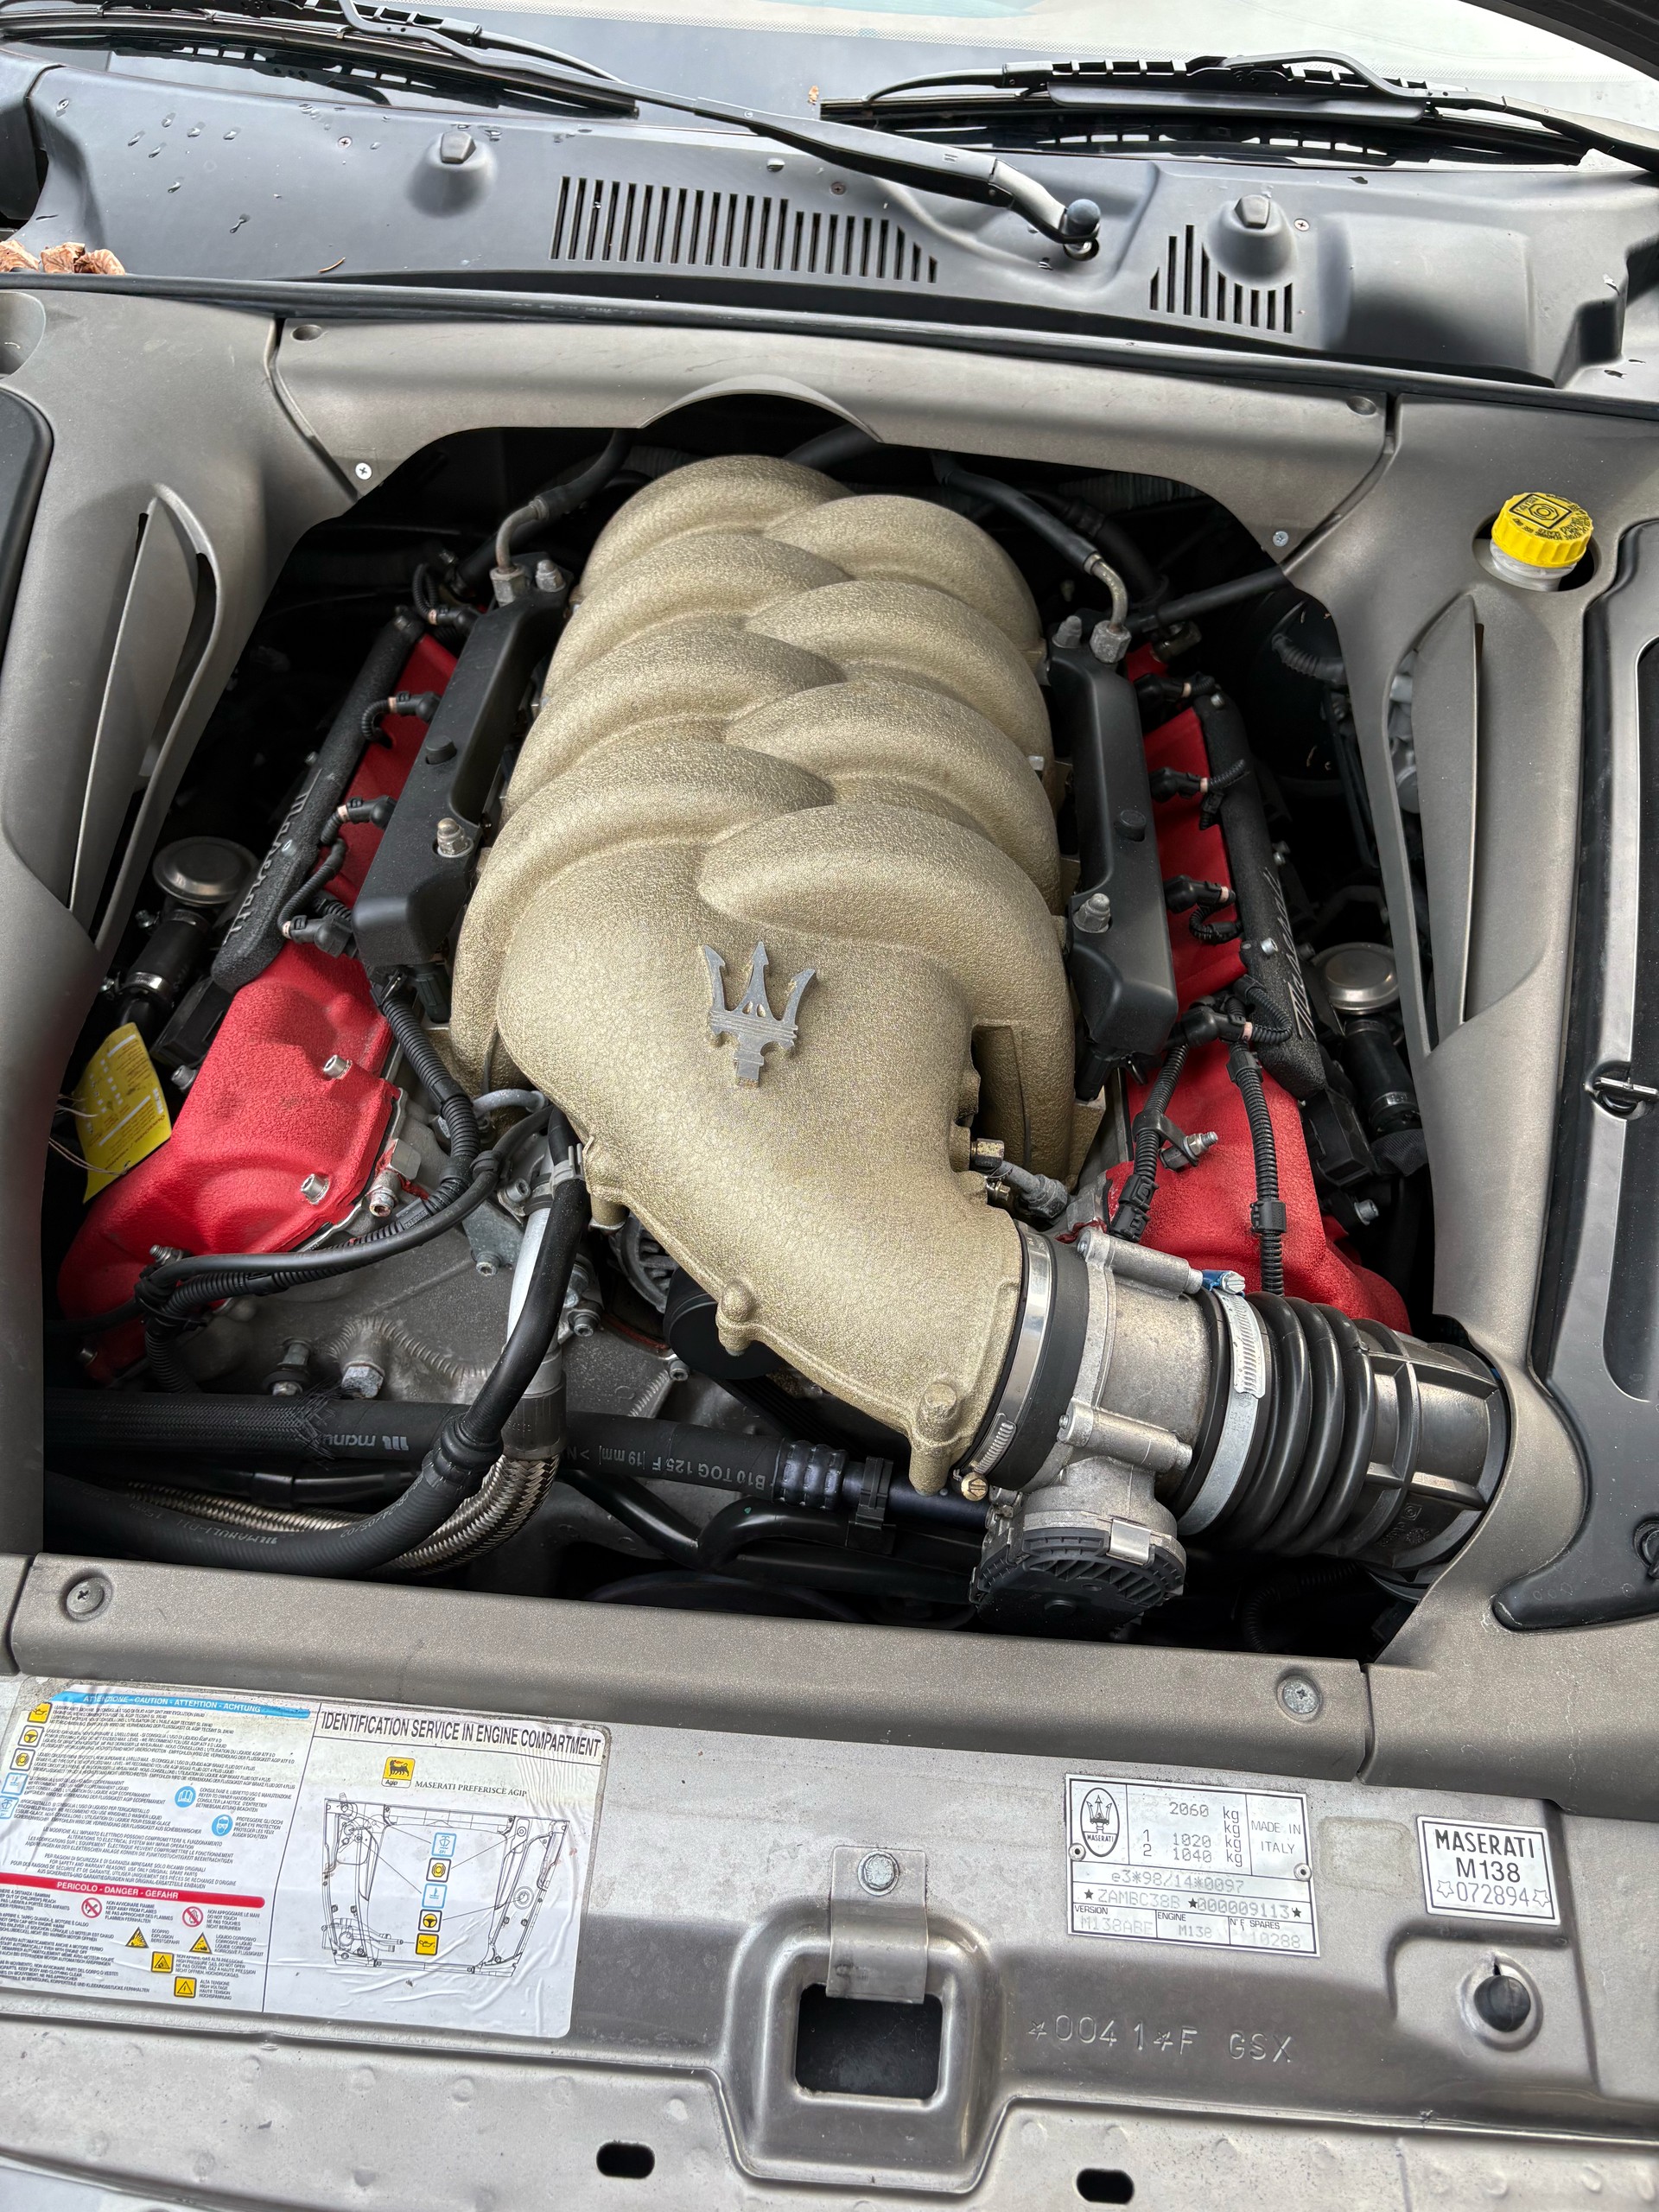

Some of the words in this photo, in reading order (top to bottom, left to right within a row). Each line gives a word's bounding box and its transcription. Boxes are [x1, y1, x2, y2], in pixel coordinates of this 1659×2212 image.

[666, 1459, 693, 1474] 125
[698, 1463, 732, 1482] TOG
[737, 1470, 766, 1491] B10
[83, 1695, 128, 1704] ATTENZIONE
[175, 1700, 217, 1709] ATTENTION
[223, 1703, 261, 1713] ACHTUNG
[321, 1712, 410, 1736] IDENTIFICATION
[411, 1719, 460, 1740] SERVICE
[462, 1723, 474, 1742] IN
[476, 1726, 518, 1745] ENGINE
[521, 1729, 601, 1758] COMPARTMENT
[415, 1781, 455, 1791] MASERATI
[458, 1784, 506, 1795] PREFERISCE
[507, 1789, 527, 1797] AGIP
[1169, 1802, 1210, 1817] 2060
[1224, 1806, 1239, 1823] kg
[1224, 1821, 1240, 1838] kg
[1251, 1821, 1281, 1834] MADE
[1289, 1825, 1301, 1835] IN
[1087, 1834, 1114, 1843] MASERATI
[1143, 1829, 1150, 1842] 1
[1173, 1833, 1211, 1848] 1020
[1225, 1834, 1242, 1853] kg
[1261, 1840, 1294, 1854] ITALY
[1434, 1829, 1535, 1858] MASERATI
[1143, 1843, 1152, 1857] 2
[1173, 1847, 1211, 1863] 1040
[1226, 1849, 1243, 1867] kg
[1456, 1857, 1521, 1883] M138
[57, 1882, 99, 1892] PERICOLO
[105, 1885, 139, 1896] DANGER
[145, 1889, 179, 1899] GEFAHR
[1456, 1882, 1529, 1907] 072894
[1075, 1905, 1109, 1915] VERSION
[1157, 1912, 1186, 1922] ENGINE
[1249, 1921, 1281, 1930] SPARES
[1229, 2032, 1293, 2063] GSX
